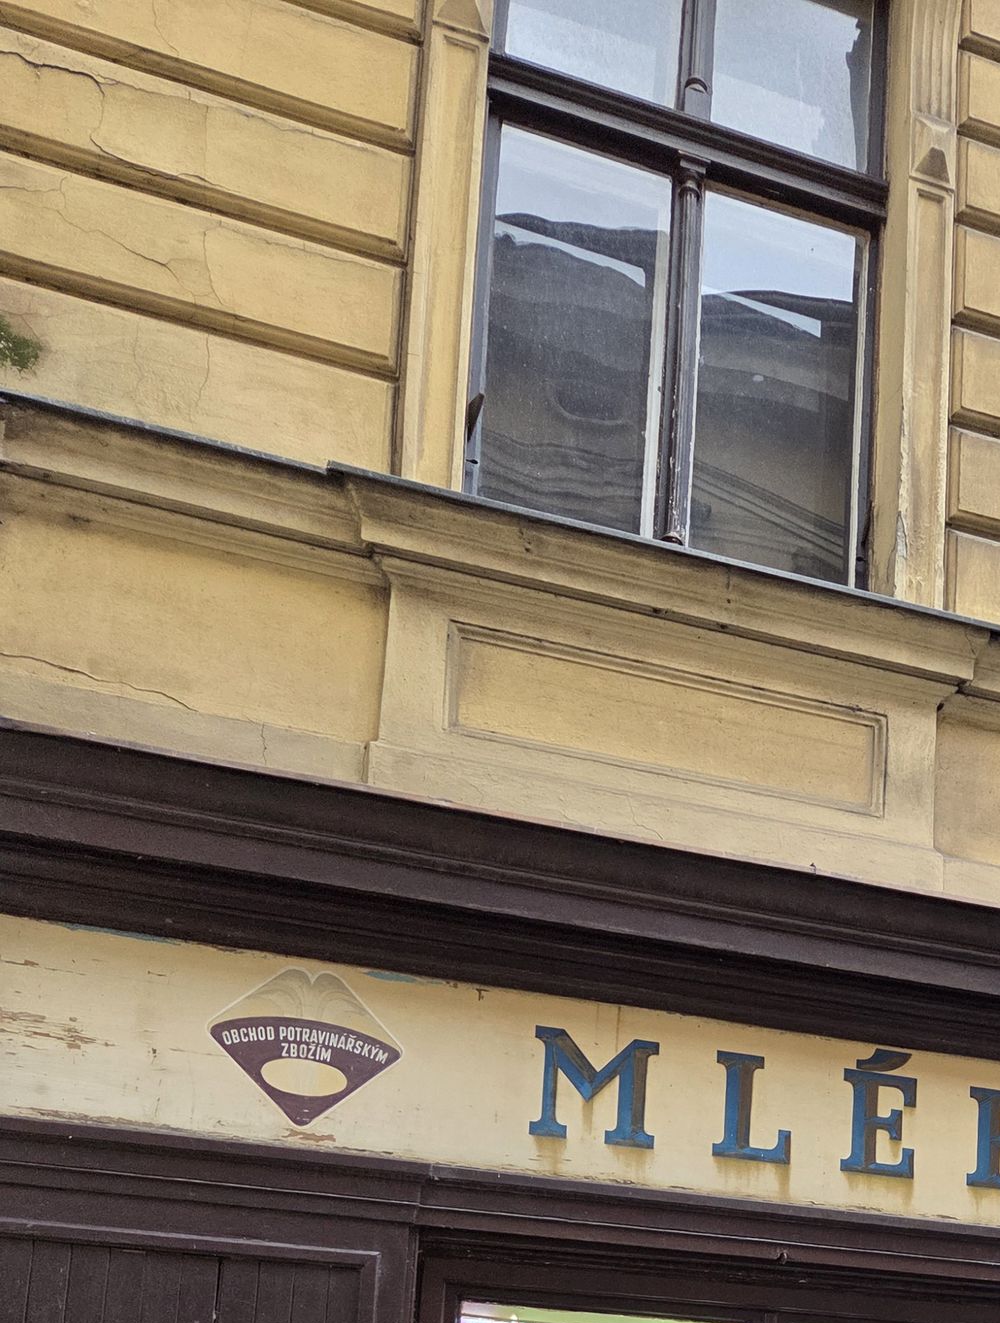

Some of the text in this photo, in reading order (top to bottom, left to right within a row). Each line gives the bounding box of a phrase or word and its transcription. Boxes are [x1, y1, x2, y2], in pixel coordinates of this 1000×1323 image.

[222, 1025, 389, 1065] OBCHOD POTRAVINÁŘSKÝM
[281, 1040, 332, 1062] ZBOŽÍM
